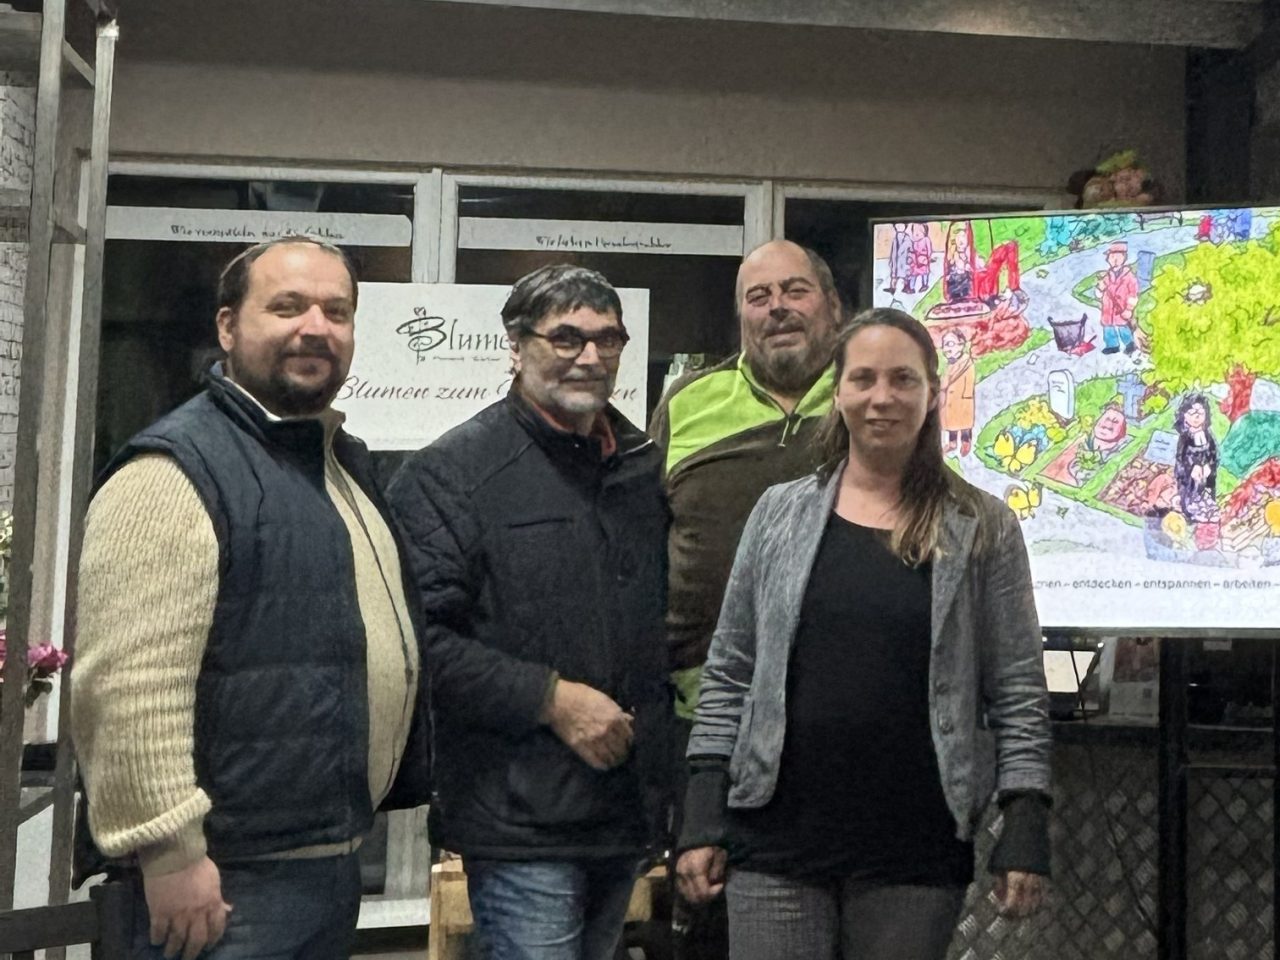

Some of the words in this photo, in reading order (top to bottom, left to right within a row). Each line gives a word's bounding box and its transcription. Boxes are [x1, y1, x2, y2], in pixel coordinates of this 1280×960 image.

[396, 316, 510, 352] Blume
[435, 387, 488, 401] zum
[1143, 579, 1211, 590] entspannen
